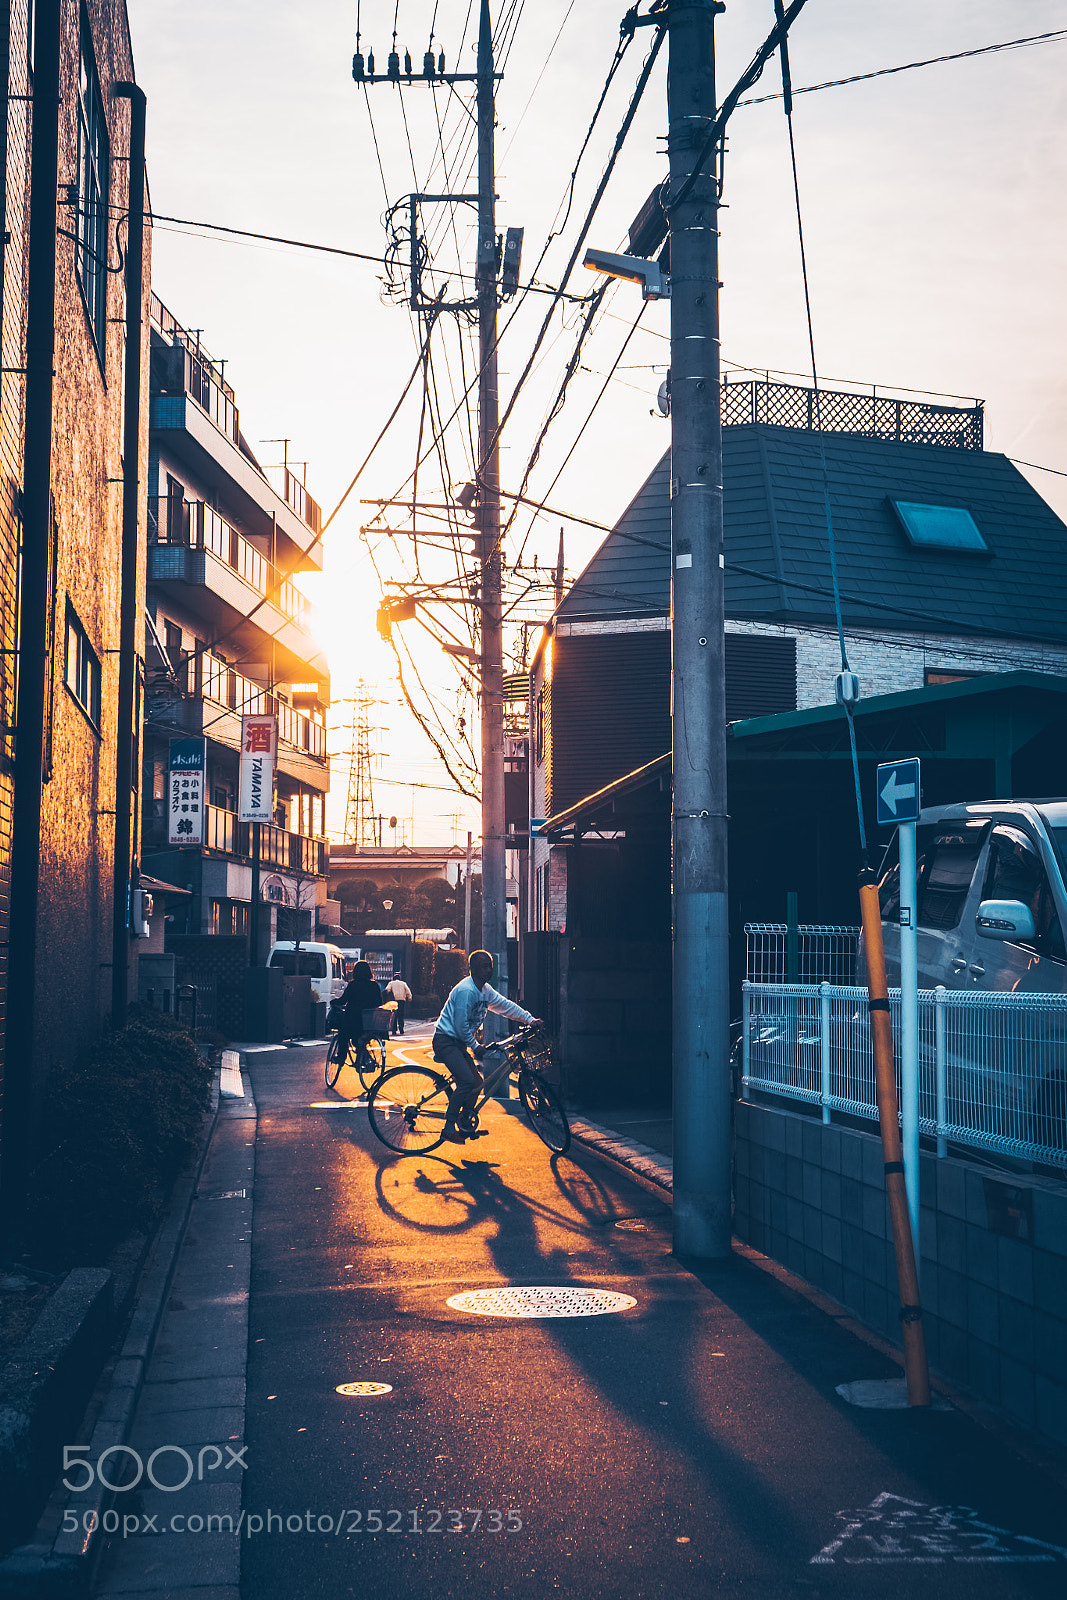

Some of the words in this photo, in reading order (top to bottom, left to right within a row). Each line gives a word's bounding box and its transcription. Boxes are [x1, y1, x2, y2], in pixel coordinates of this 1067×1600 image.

[245, 723, 271, 753] 酒
[172, 754, 200, 765] Asahi
[172, 779, 180, 813] カラオケ
[181, 779, 190, 813] お食事
[190, 779, 199, 813] 小料理
[251, 758, 262, 808] TAMAYA
